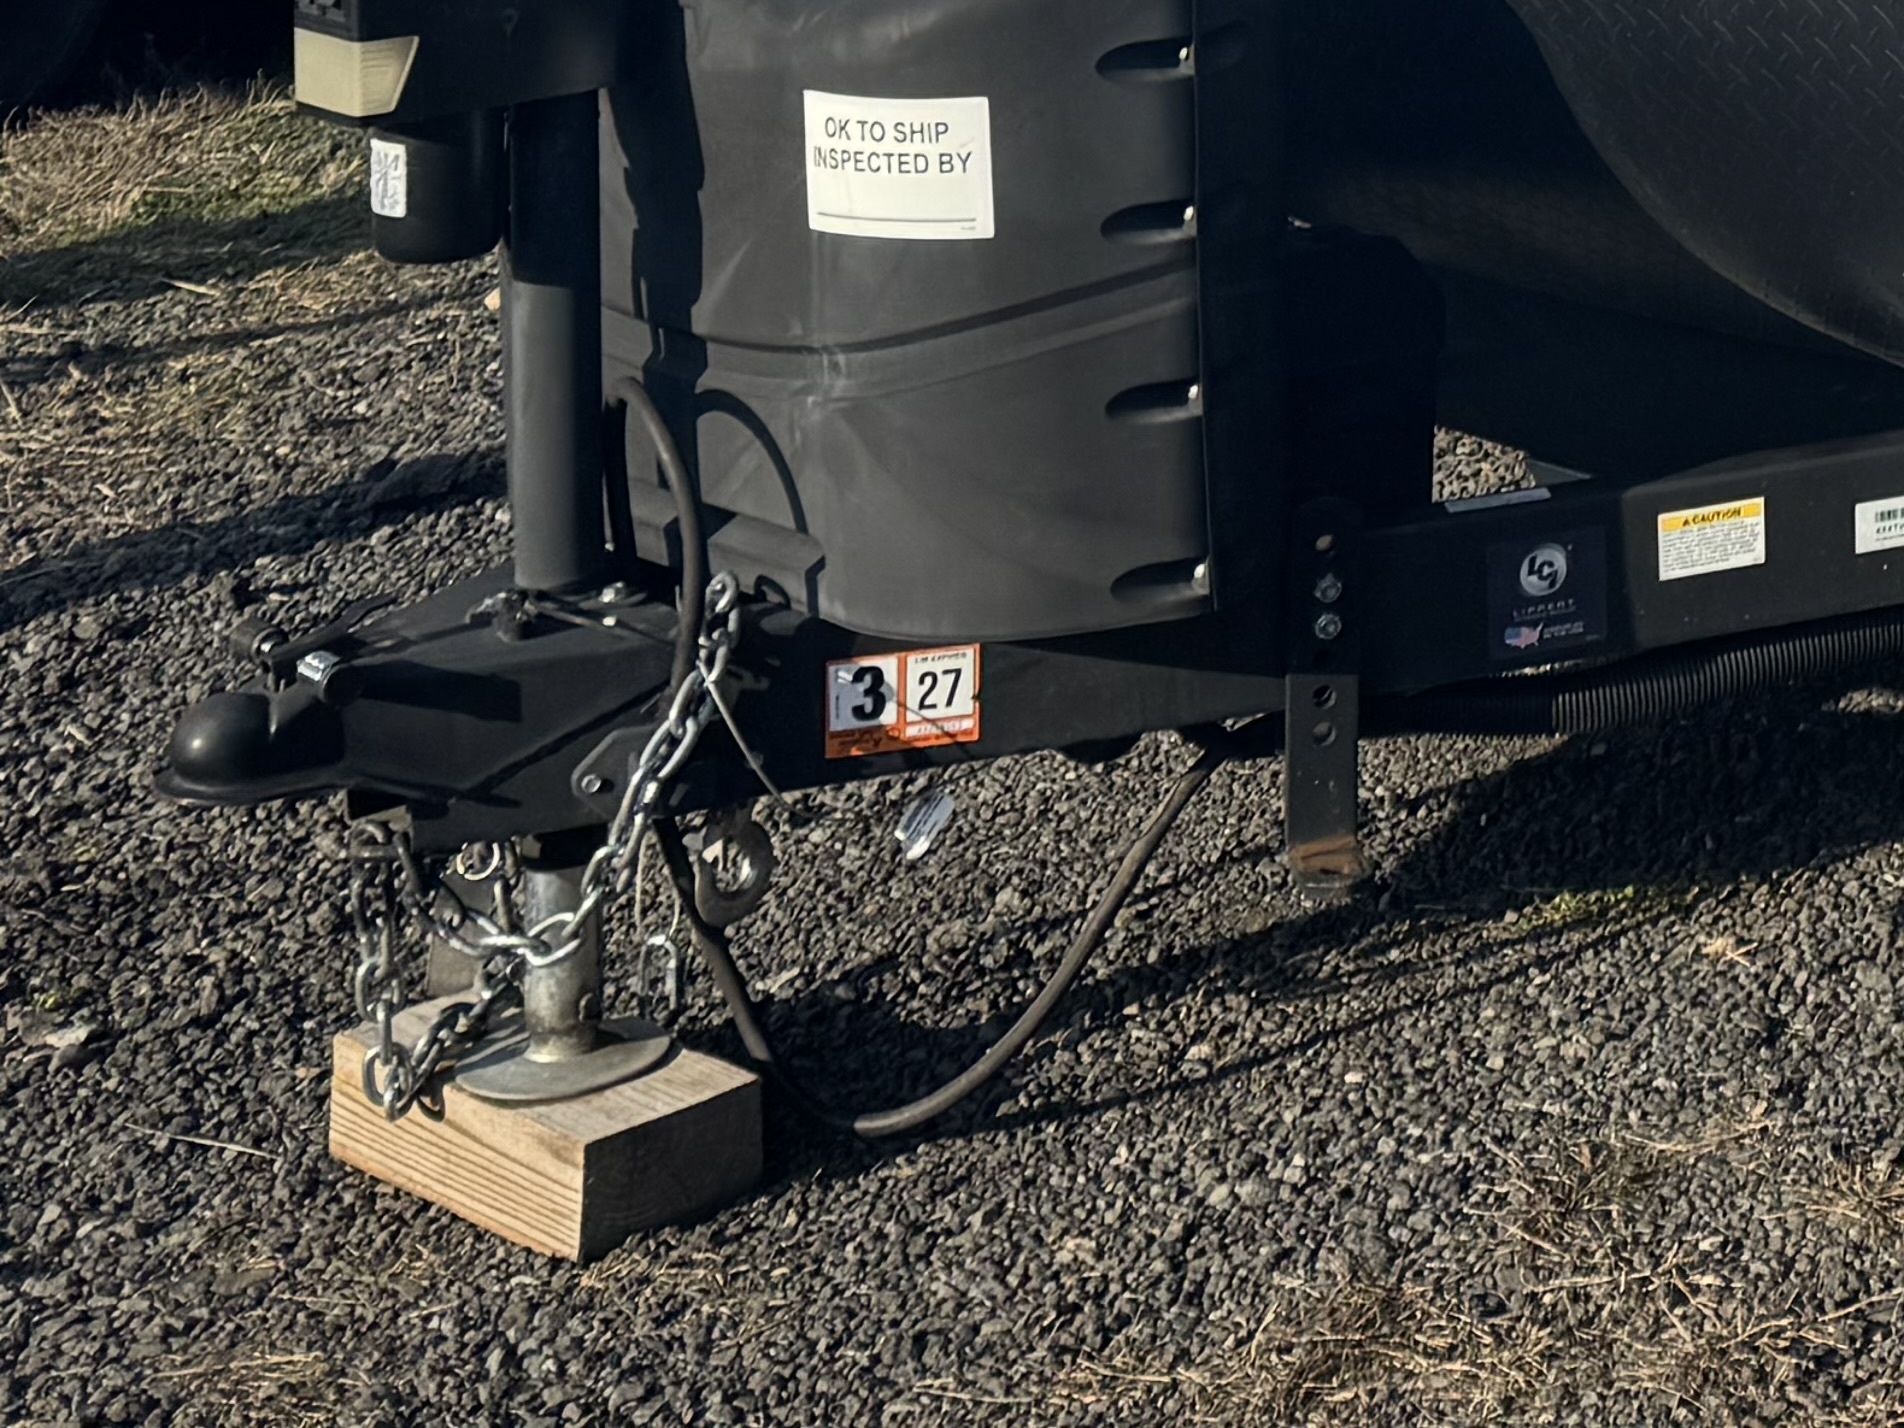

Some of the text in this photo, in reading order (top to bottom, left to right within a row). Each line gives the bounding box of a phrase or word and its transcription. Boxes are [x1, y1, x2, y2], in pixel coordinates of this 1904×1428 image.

[824, 116, 949, 144] OK TO SHIP
[813, 145, 973, 175] INSPECTED BY
[1692, 506, 1741, 525] CAUTION
[851, 665, 887, 722] 3
[917, 667, 963, 711] 27
